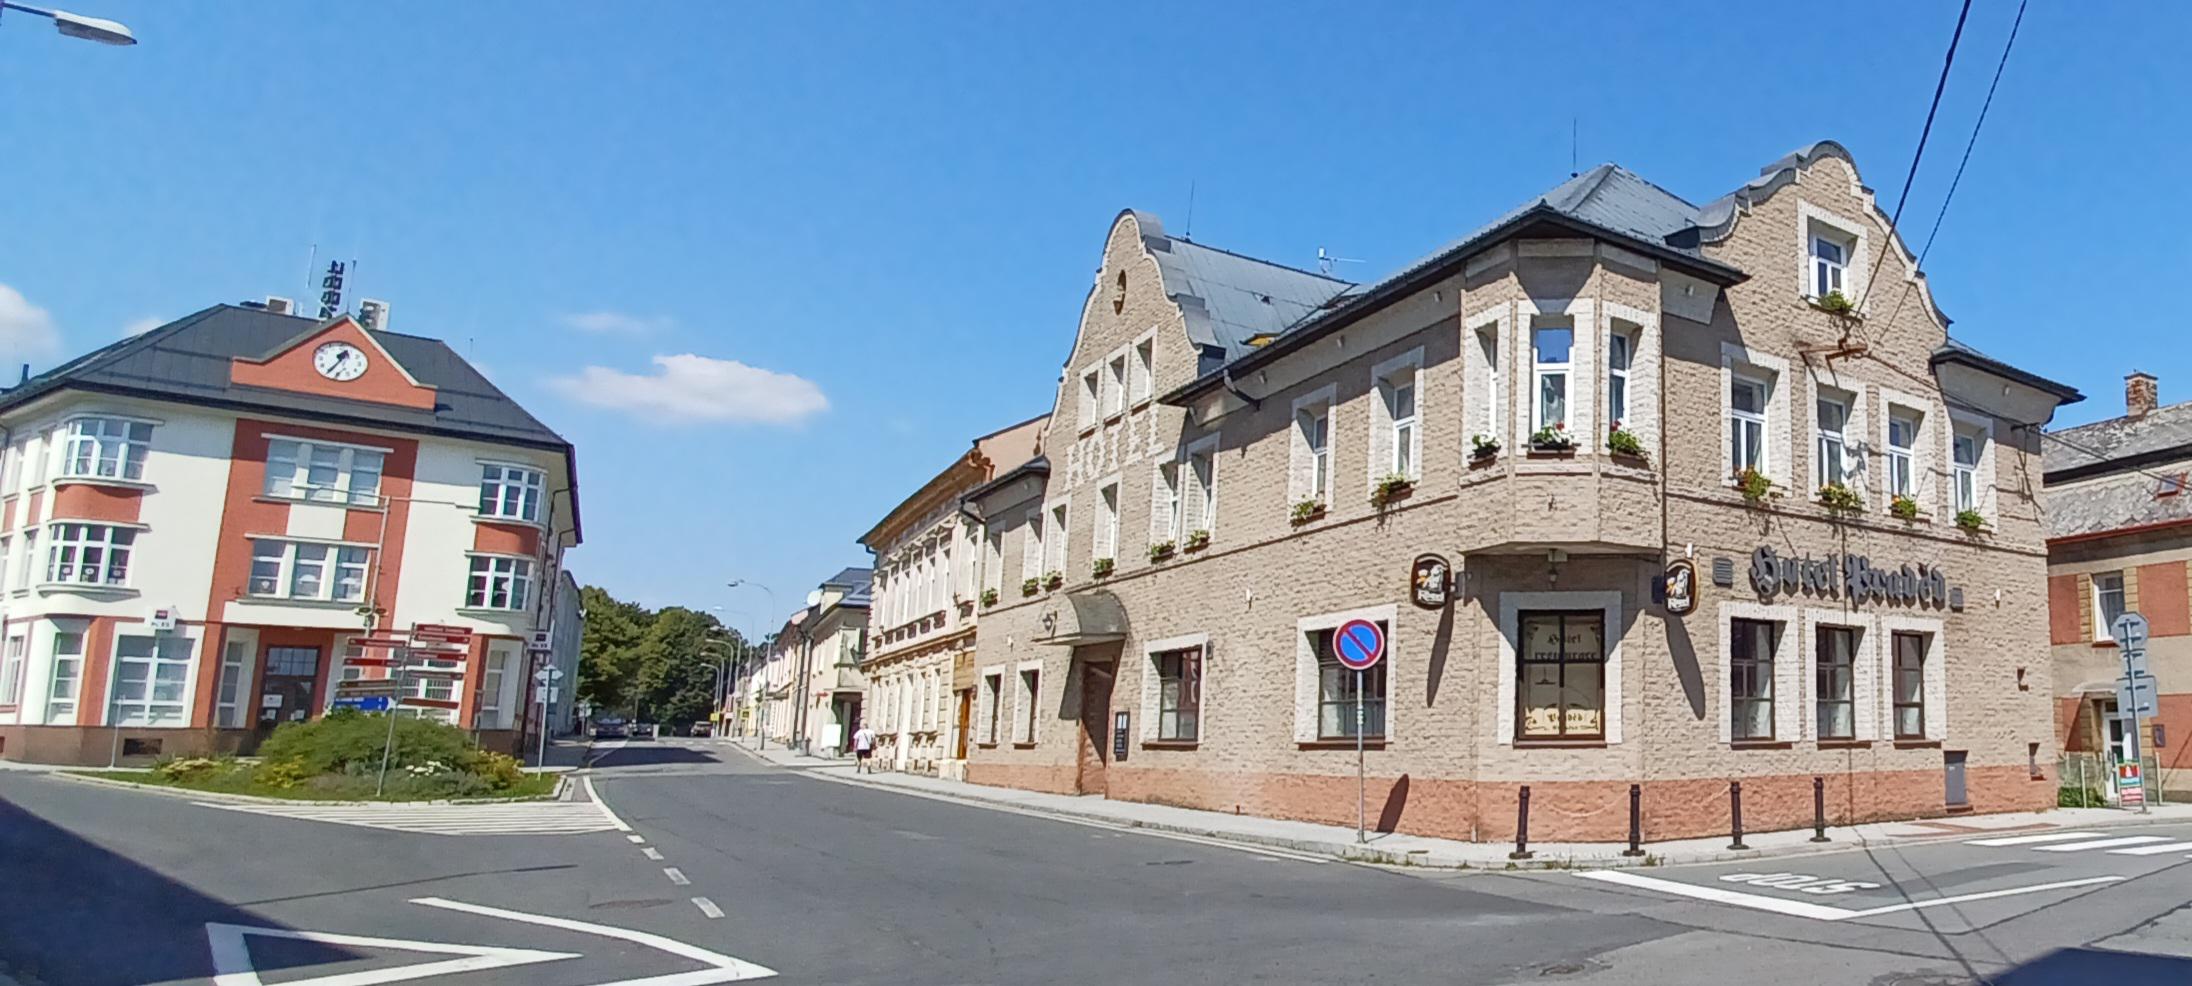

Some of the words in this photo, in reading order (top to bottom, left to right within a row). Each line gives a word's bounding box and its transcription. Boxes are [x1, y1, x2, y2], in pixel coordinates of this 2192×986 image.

[1064, 403, 1165, 491] HOTEL
[1749, 544, 1839, 600] Hotel
[1547, 633, 1581, 645] Htel
[1719, 872, 1881, 895] STOP
